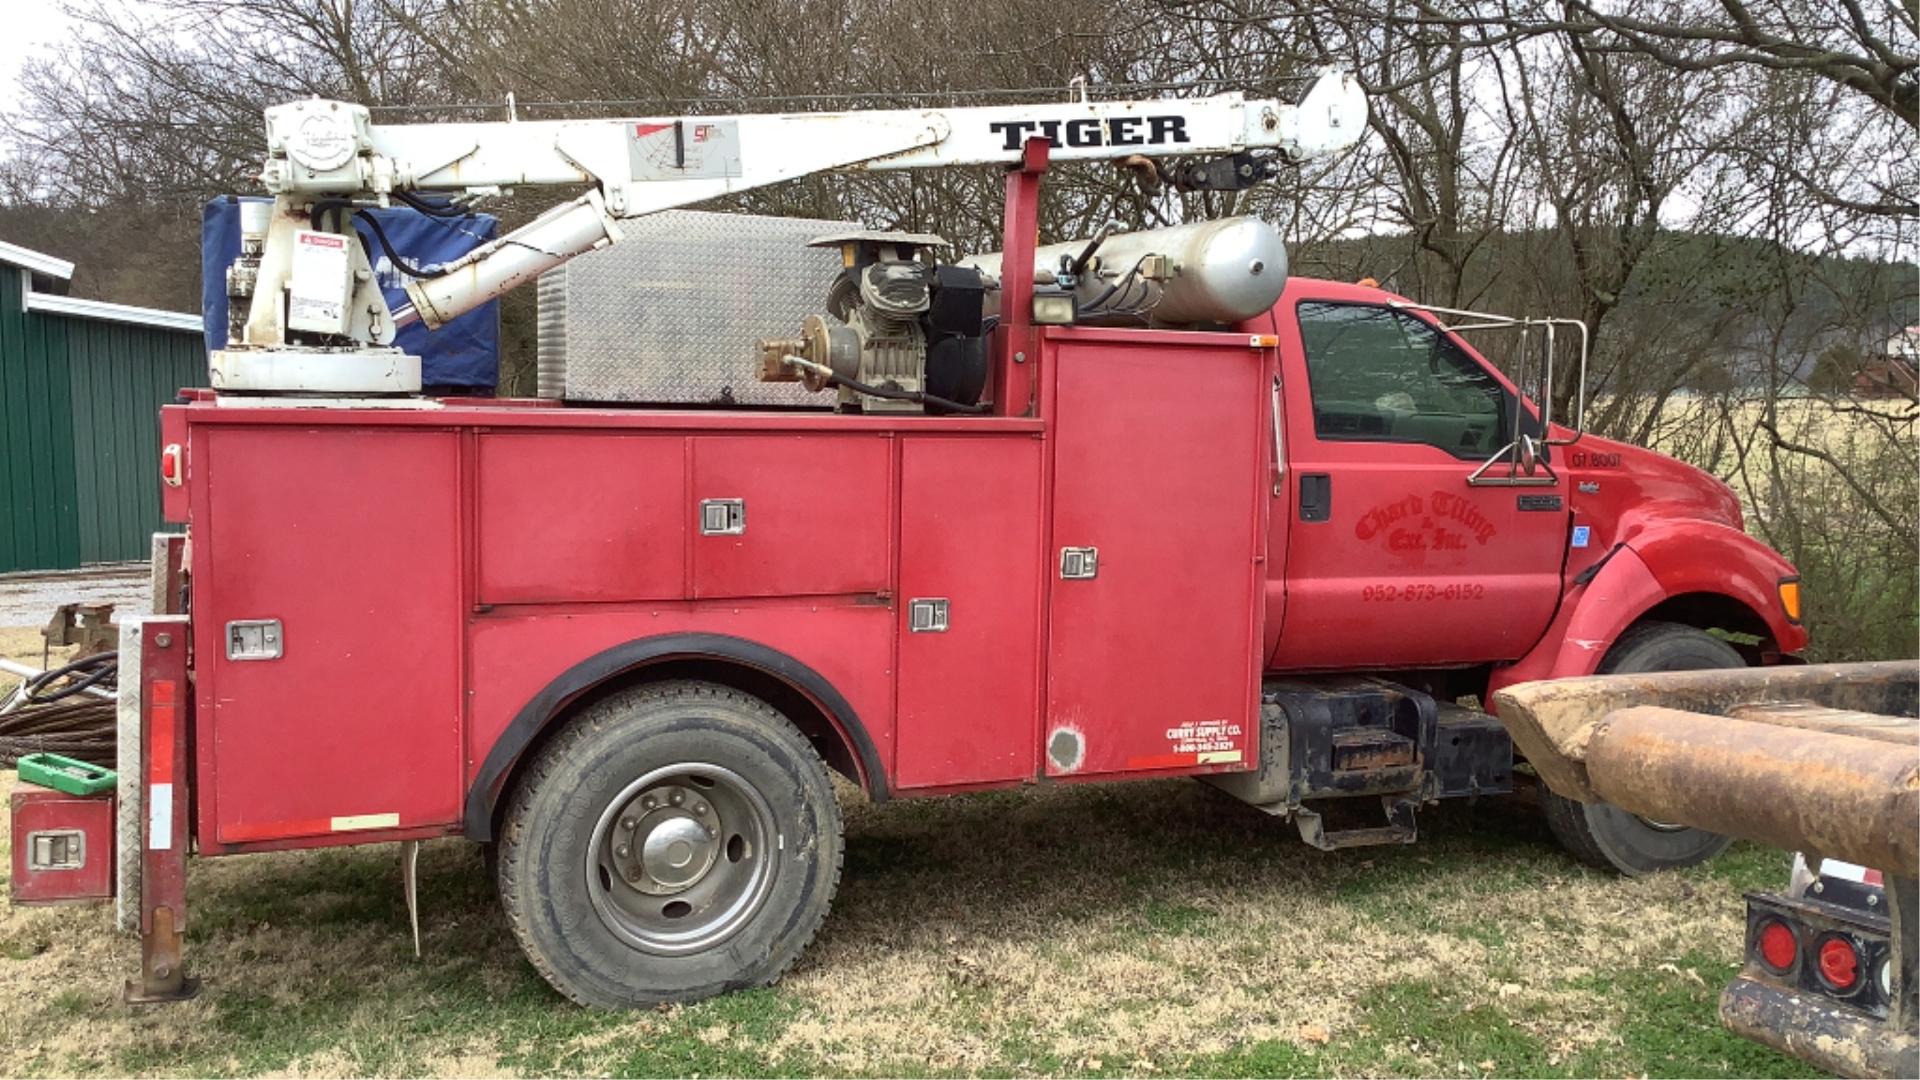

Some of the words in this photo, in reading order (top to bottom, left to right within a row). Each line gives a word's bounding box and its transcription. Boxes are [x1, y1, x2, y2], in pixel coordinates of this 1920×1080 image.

[990, 115, 1191, 150] TIGER
[1362, 583, 1485, 602] 952-873-6152
[1166, 728, 1194, 739] CURRY
[1195, 726, 1226, 737] SUPPLY
[1227, 724, 1241, 735] CO.
